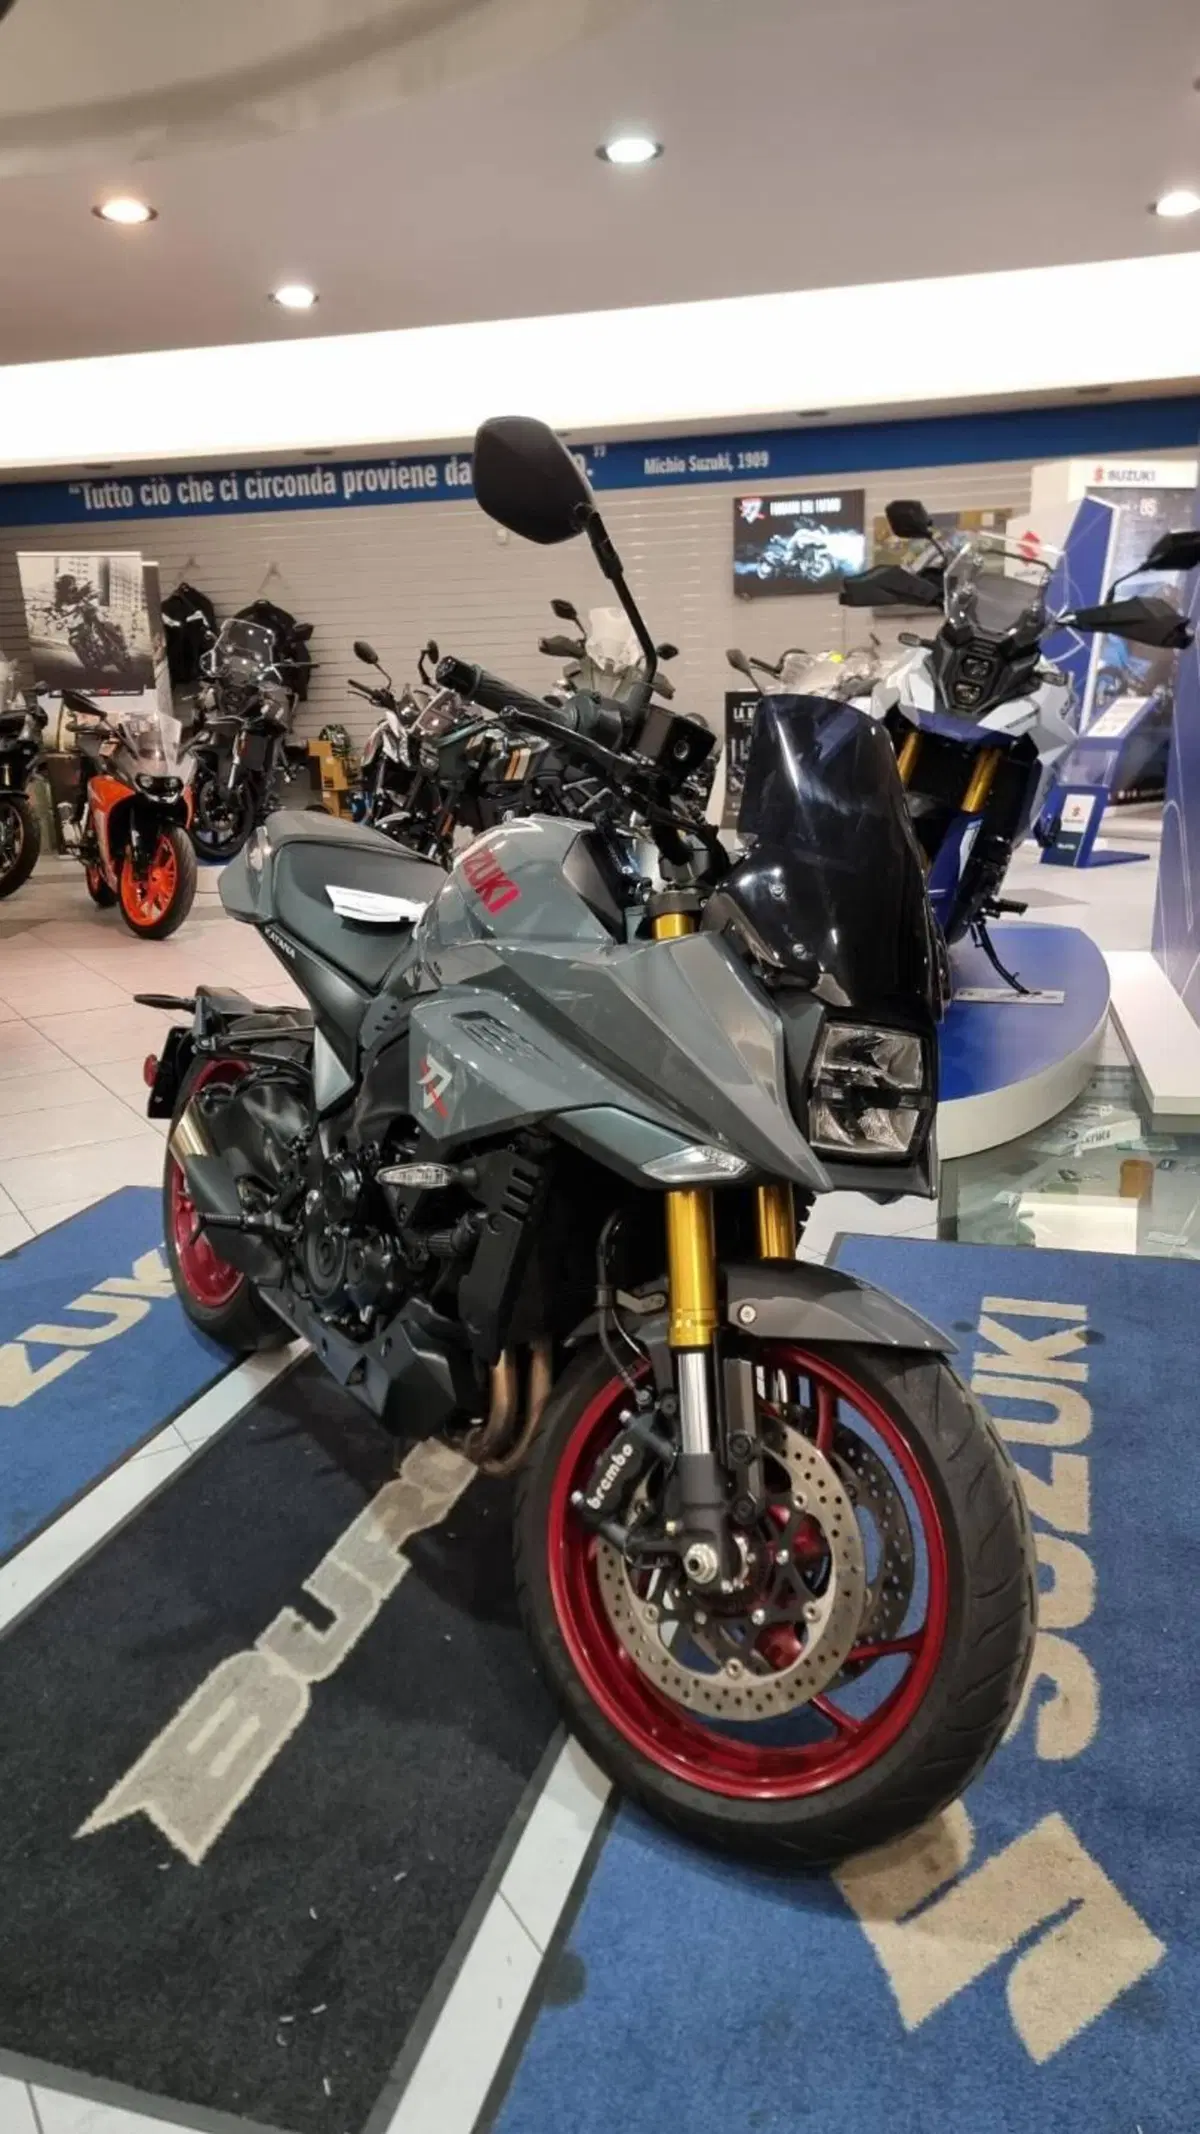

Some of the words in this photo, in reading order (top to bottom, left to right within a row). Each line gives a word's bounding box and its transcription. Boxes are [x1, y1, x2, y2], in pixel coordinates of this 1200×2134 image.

[644, 456, 686, 475] Michio
[688, 453, 734, 474] Suzuki,
[738, 450, 770, 469] 1909
[1107, 469, 1156, 481] SUZUKI
[140, 476, 171, 506] ciò
[176, 474, 214, 504] che
[219, 472, 238, 501] ci
[244, 466, 337, 500] circonda
[342, 460, 438, 499] proviene
[586, 1443, 633, 1510] brembo
